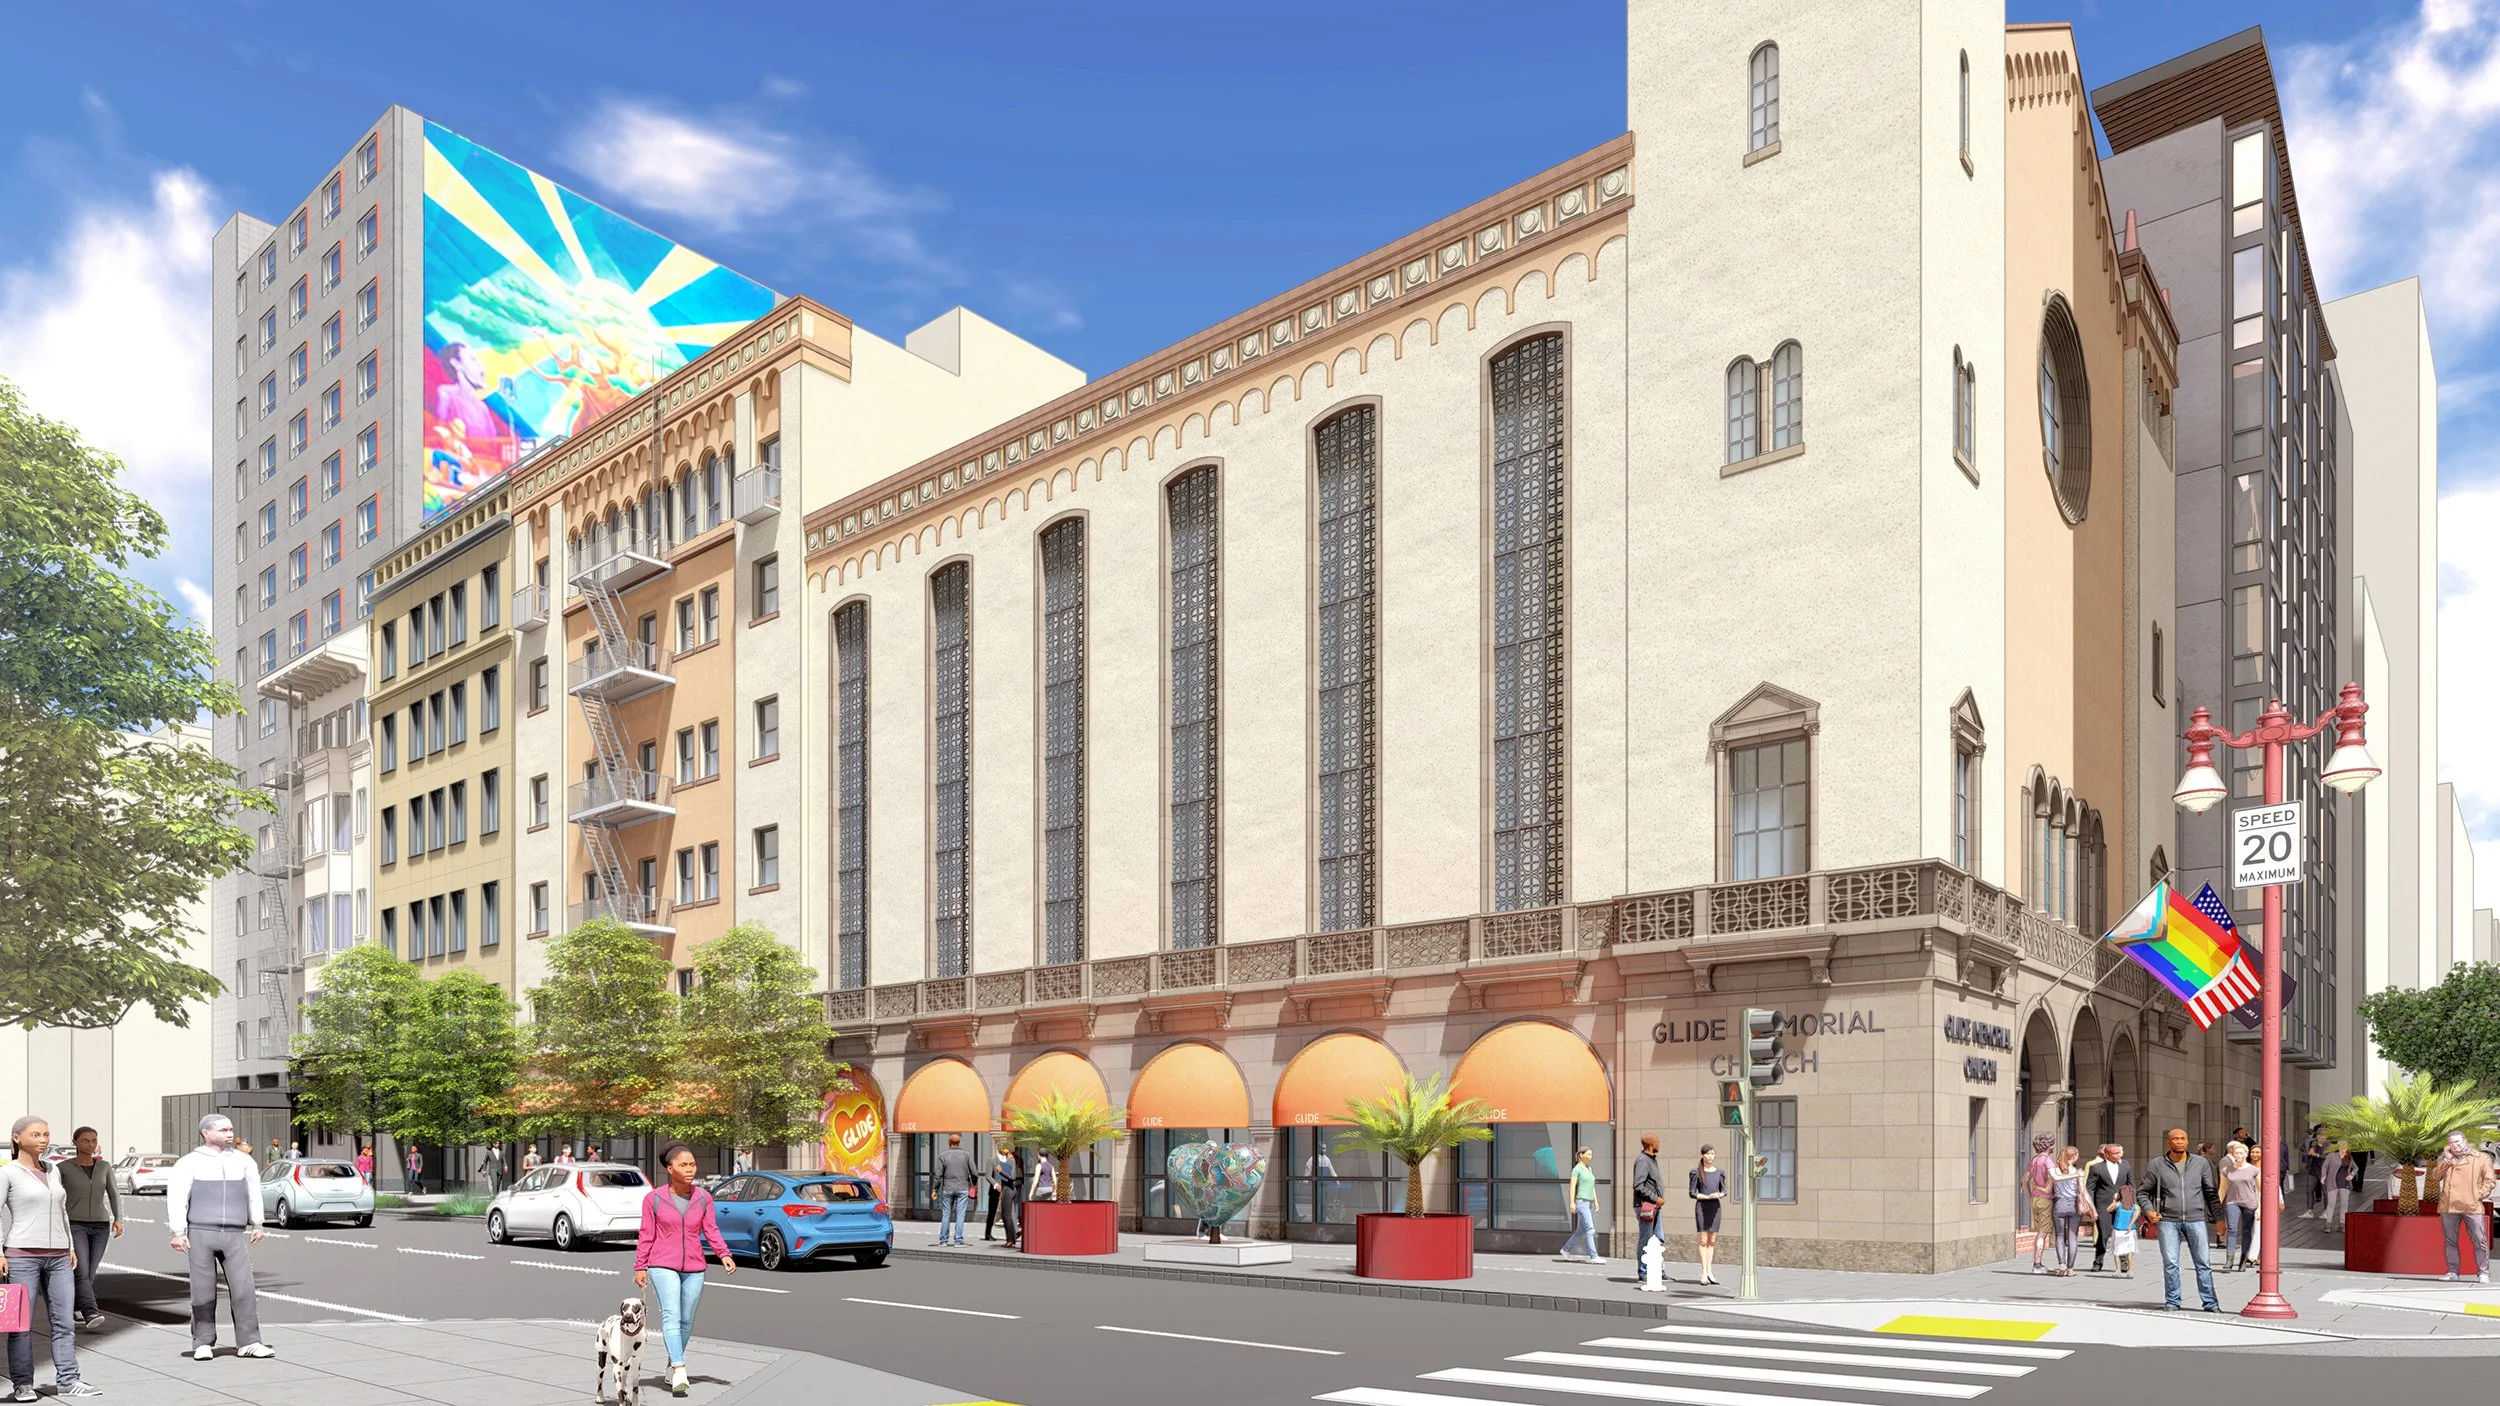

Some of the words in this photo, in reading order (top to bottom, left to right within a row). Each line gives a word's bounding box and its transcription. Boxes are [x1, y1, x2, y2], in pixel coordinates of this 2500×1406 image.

[2239, 809, 2295, 828] SPEED
[2242, 831, 2292, 866] 20
[2239, 866, 2296, 883] MAXIMUM
[1652, 1018, 1726, 1044] GLIDE
[1743, 1010, 1885, 1039] MORIAL
[1944, 1014, 1971, 1042] GLIDE
[1710, 1050, 1818, 1077] CHCH
[1963, 1055, 1997, 1082] CHURCH
[842, 1113, 875, 1149] GLIDE
[1142, 1116, 1163, 1127] GLIDE
[1294, 1112, 1320, 1124] GLIDE
